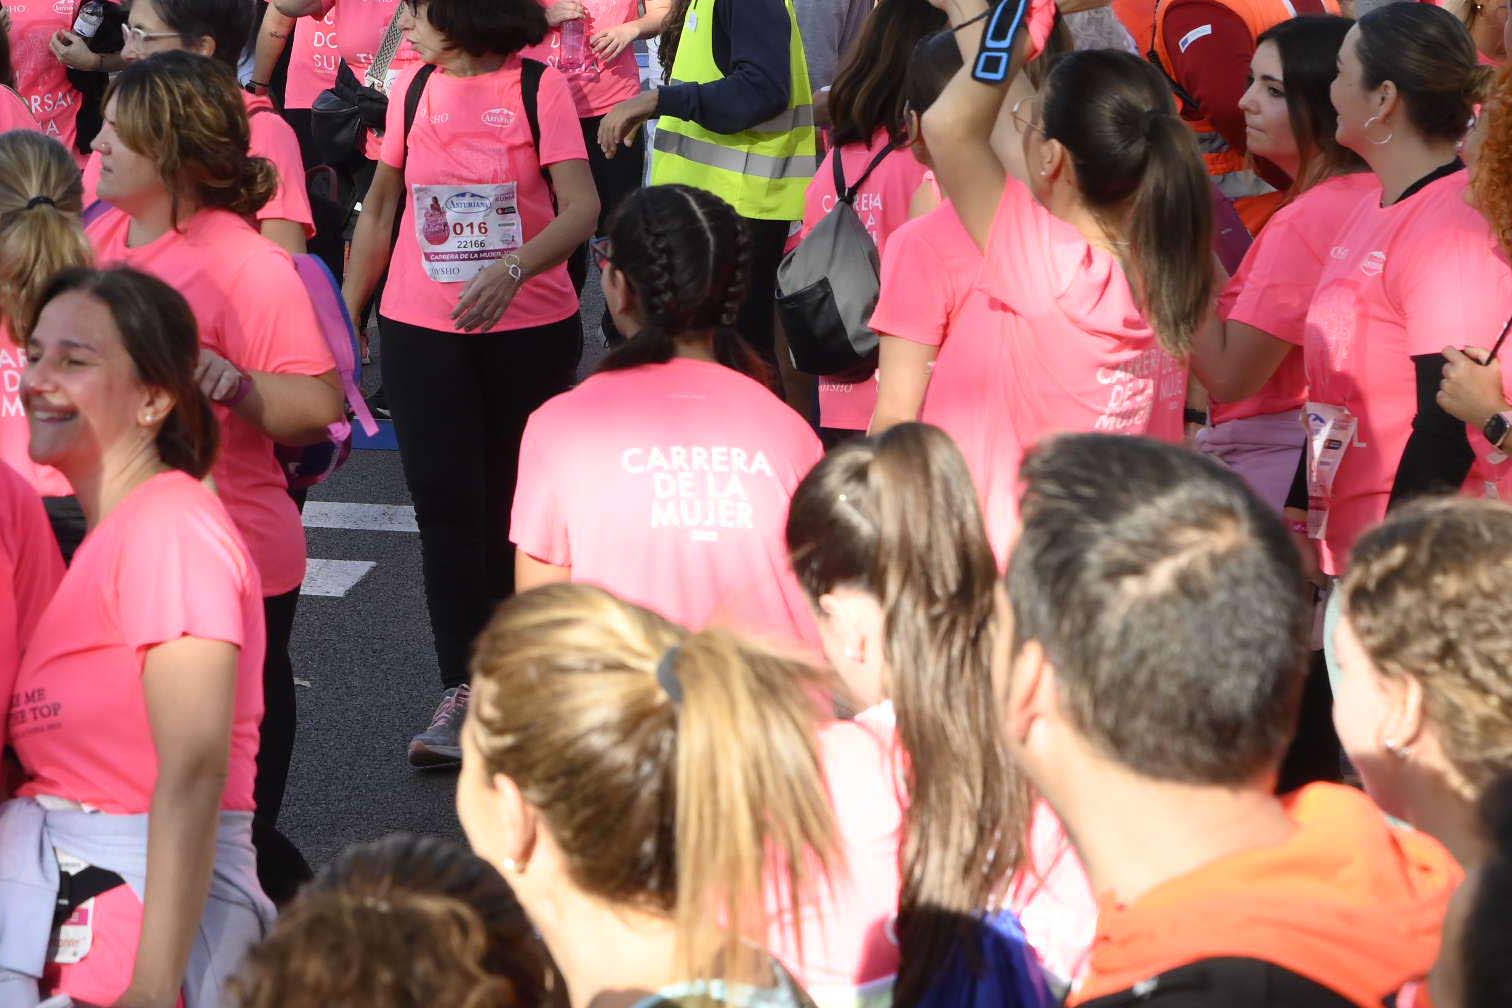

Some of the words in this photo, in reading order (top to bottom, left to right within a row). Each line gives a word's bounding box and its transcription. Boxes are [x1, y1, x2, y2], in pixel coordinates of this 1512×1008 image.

[453, 222, 488, 236] 016
[457, 240, 486, 249] 22166
[430, 253, 458, 261] CARRERA
[621, 445, 773, 477] CARRERA
[653, 472, 694, 499] DE
[706, 472, 746, 499] LA
[651, 499, 753, 529] MUJER
[25, 688, 46, 702] ME
[32, 703, 62, 720] TOP
